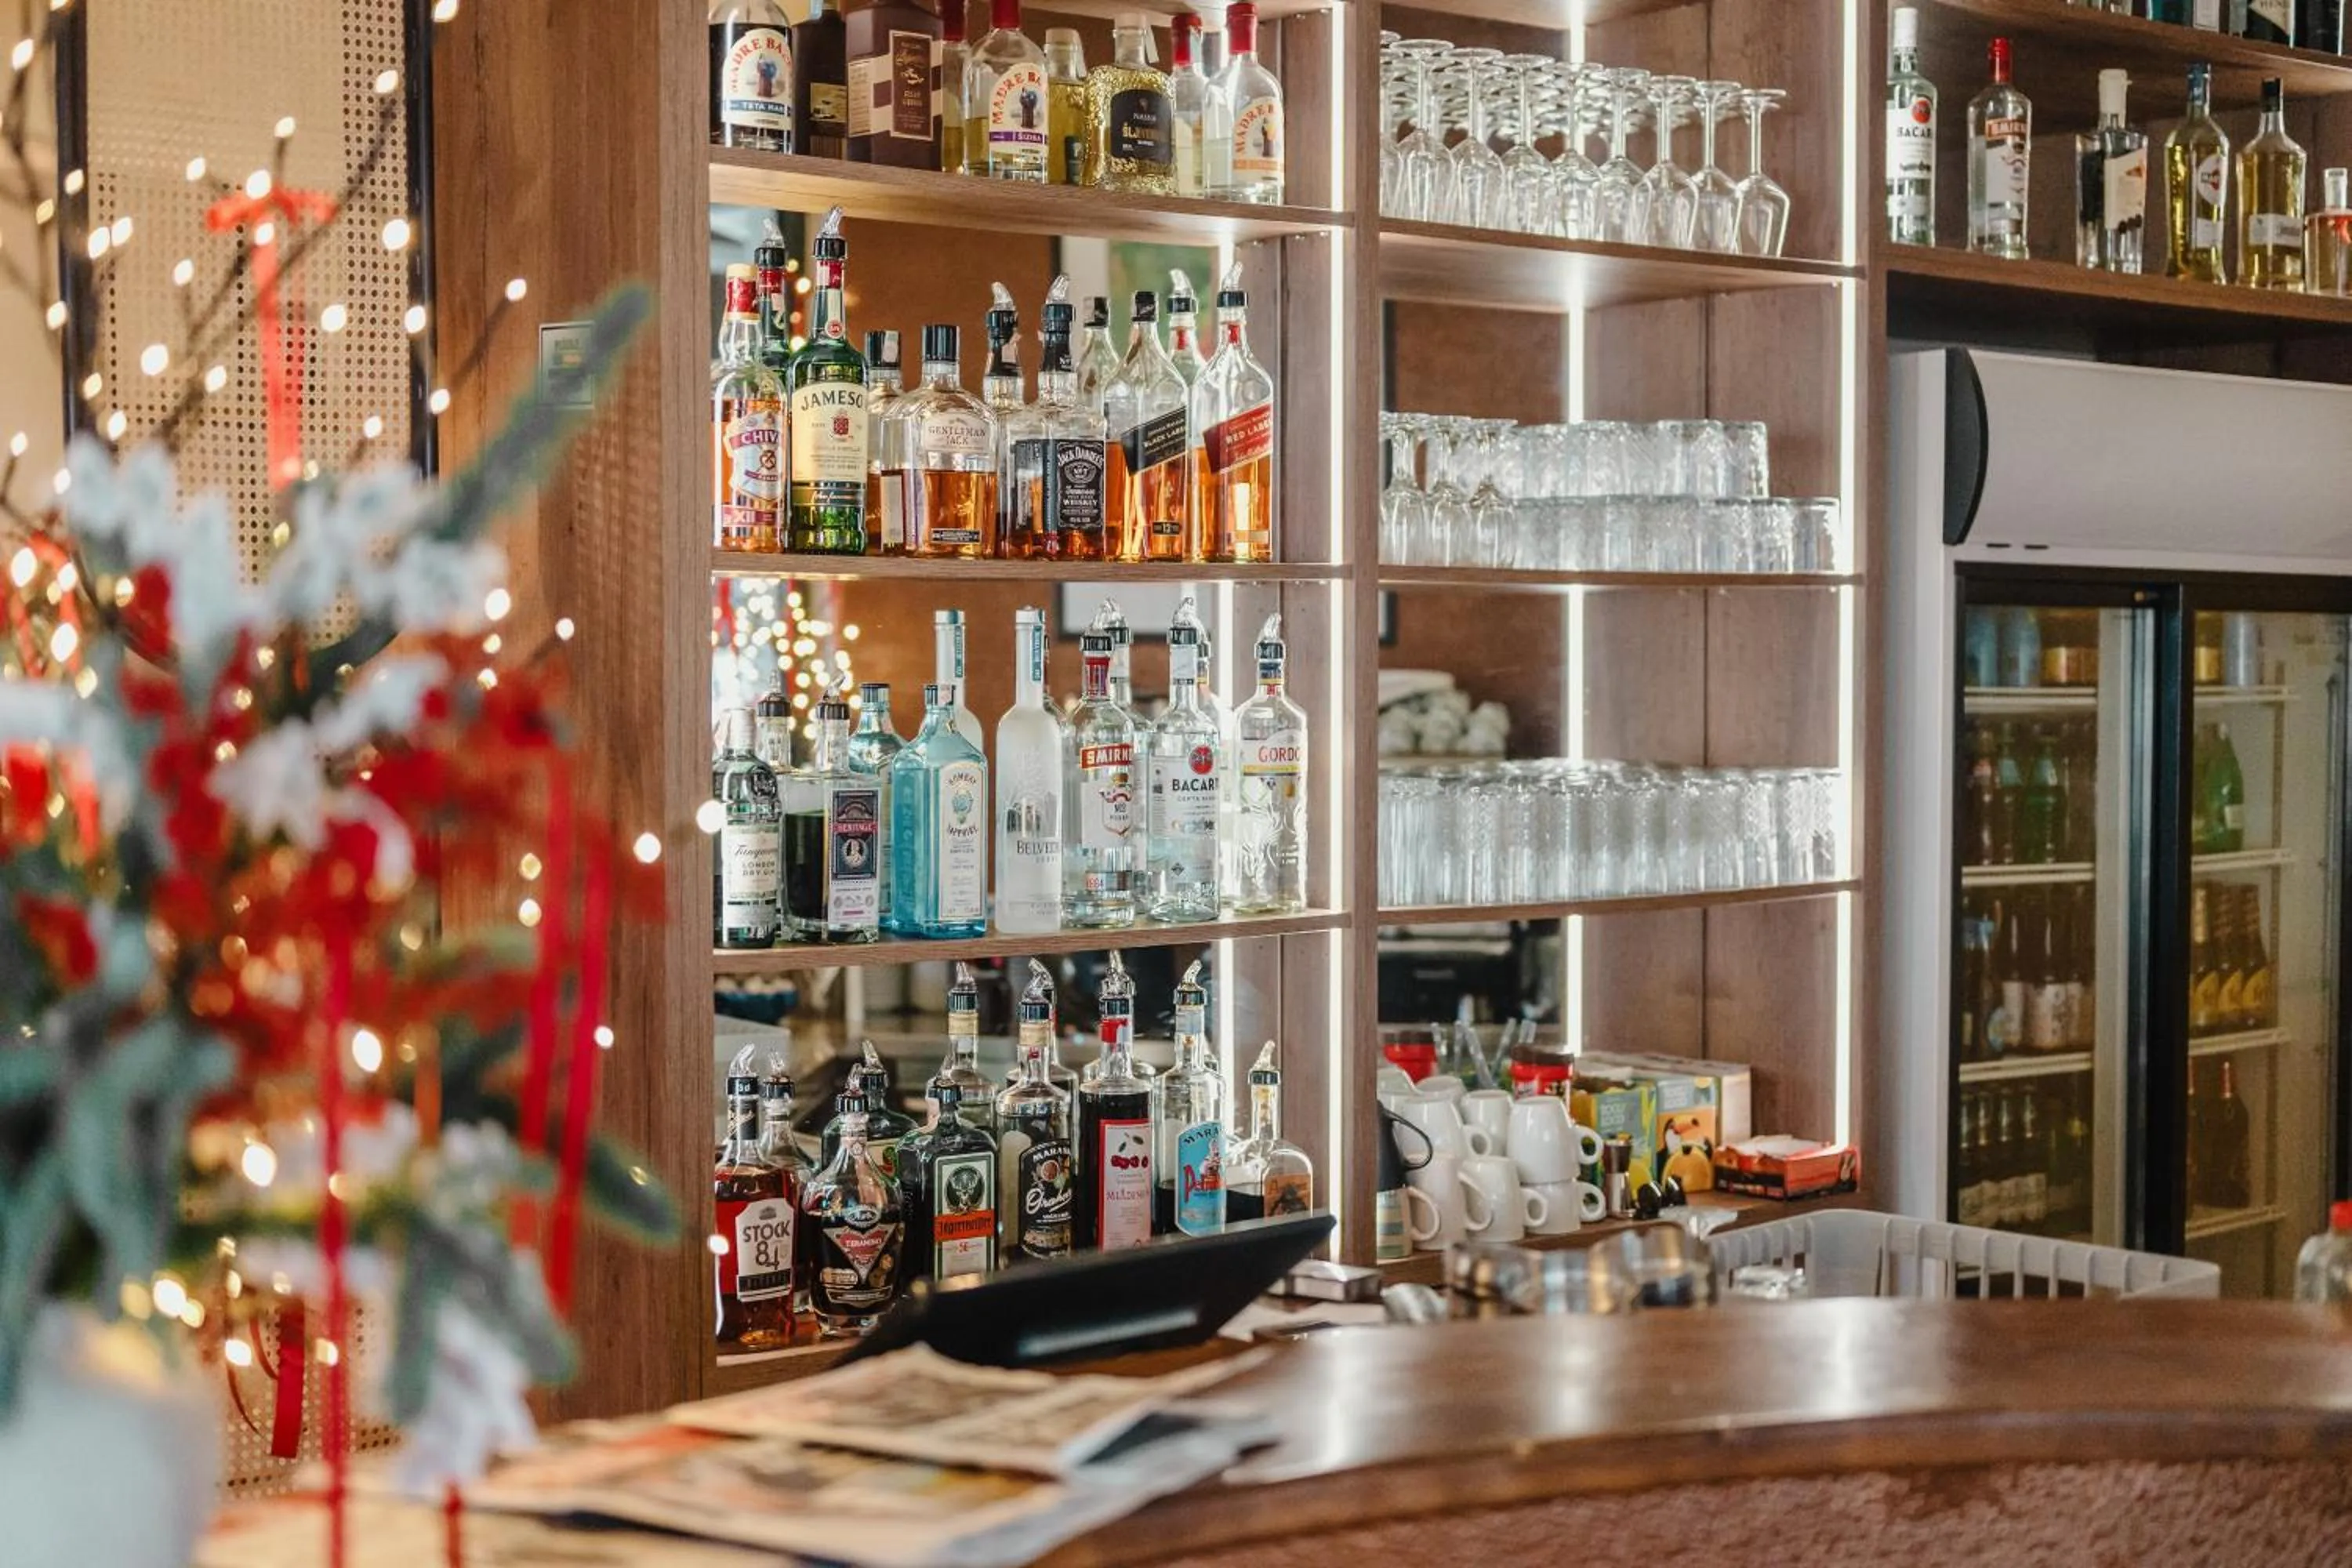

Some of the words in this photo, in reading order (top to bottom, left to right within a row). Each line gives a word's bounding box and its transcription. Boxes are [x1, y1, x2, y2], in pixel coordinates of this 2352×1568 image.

[993, 73, 1024, 124] MADRE
[801, 390, 864, 411] JAMESO
[741, 430, 779, 445] CHIV
[928, 426, 985, 437] GENTLEMAN
[1225, 430, 1246, 445] RED
[1184, 1126, 1220, 1144] MARA
[742, 1219, 790, 1243] STOCK
[755, 1240, 780, 1271] 84
